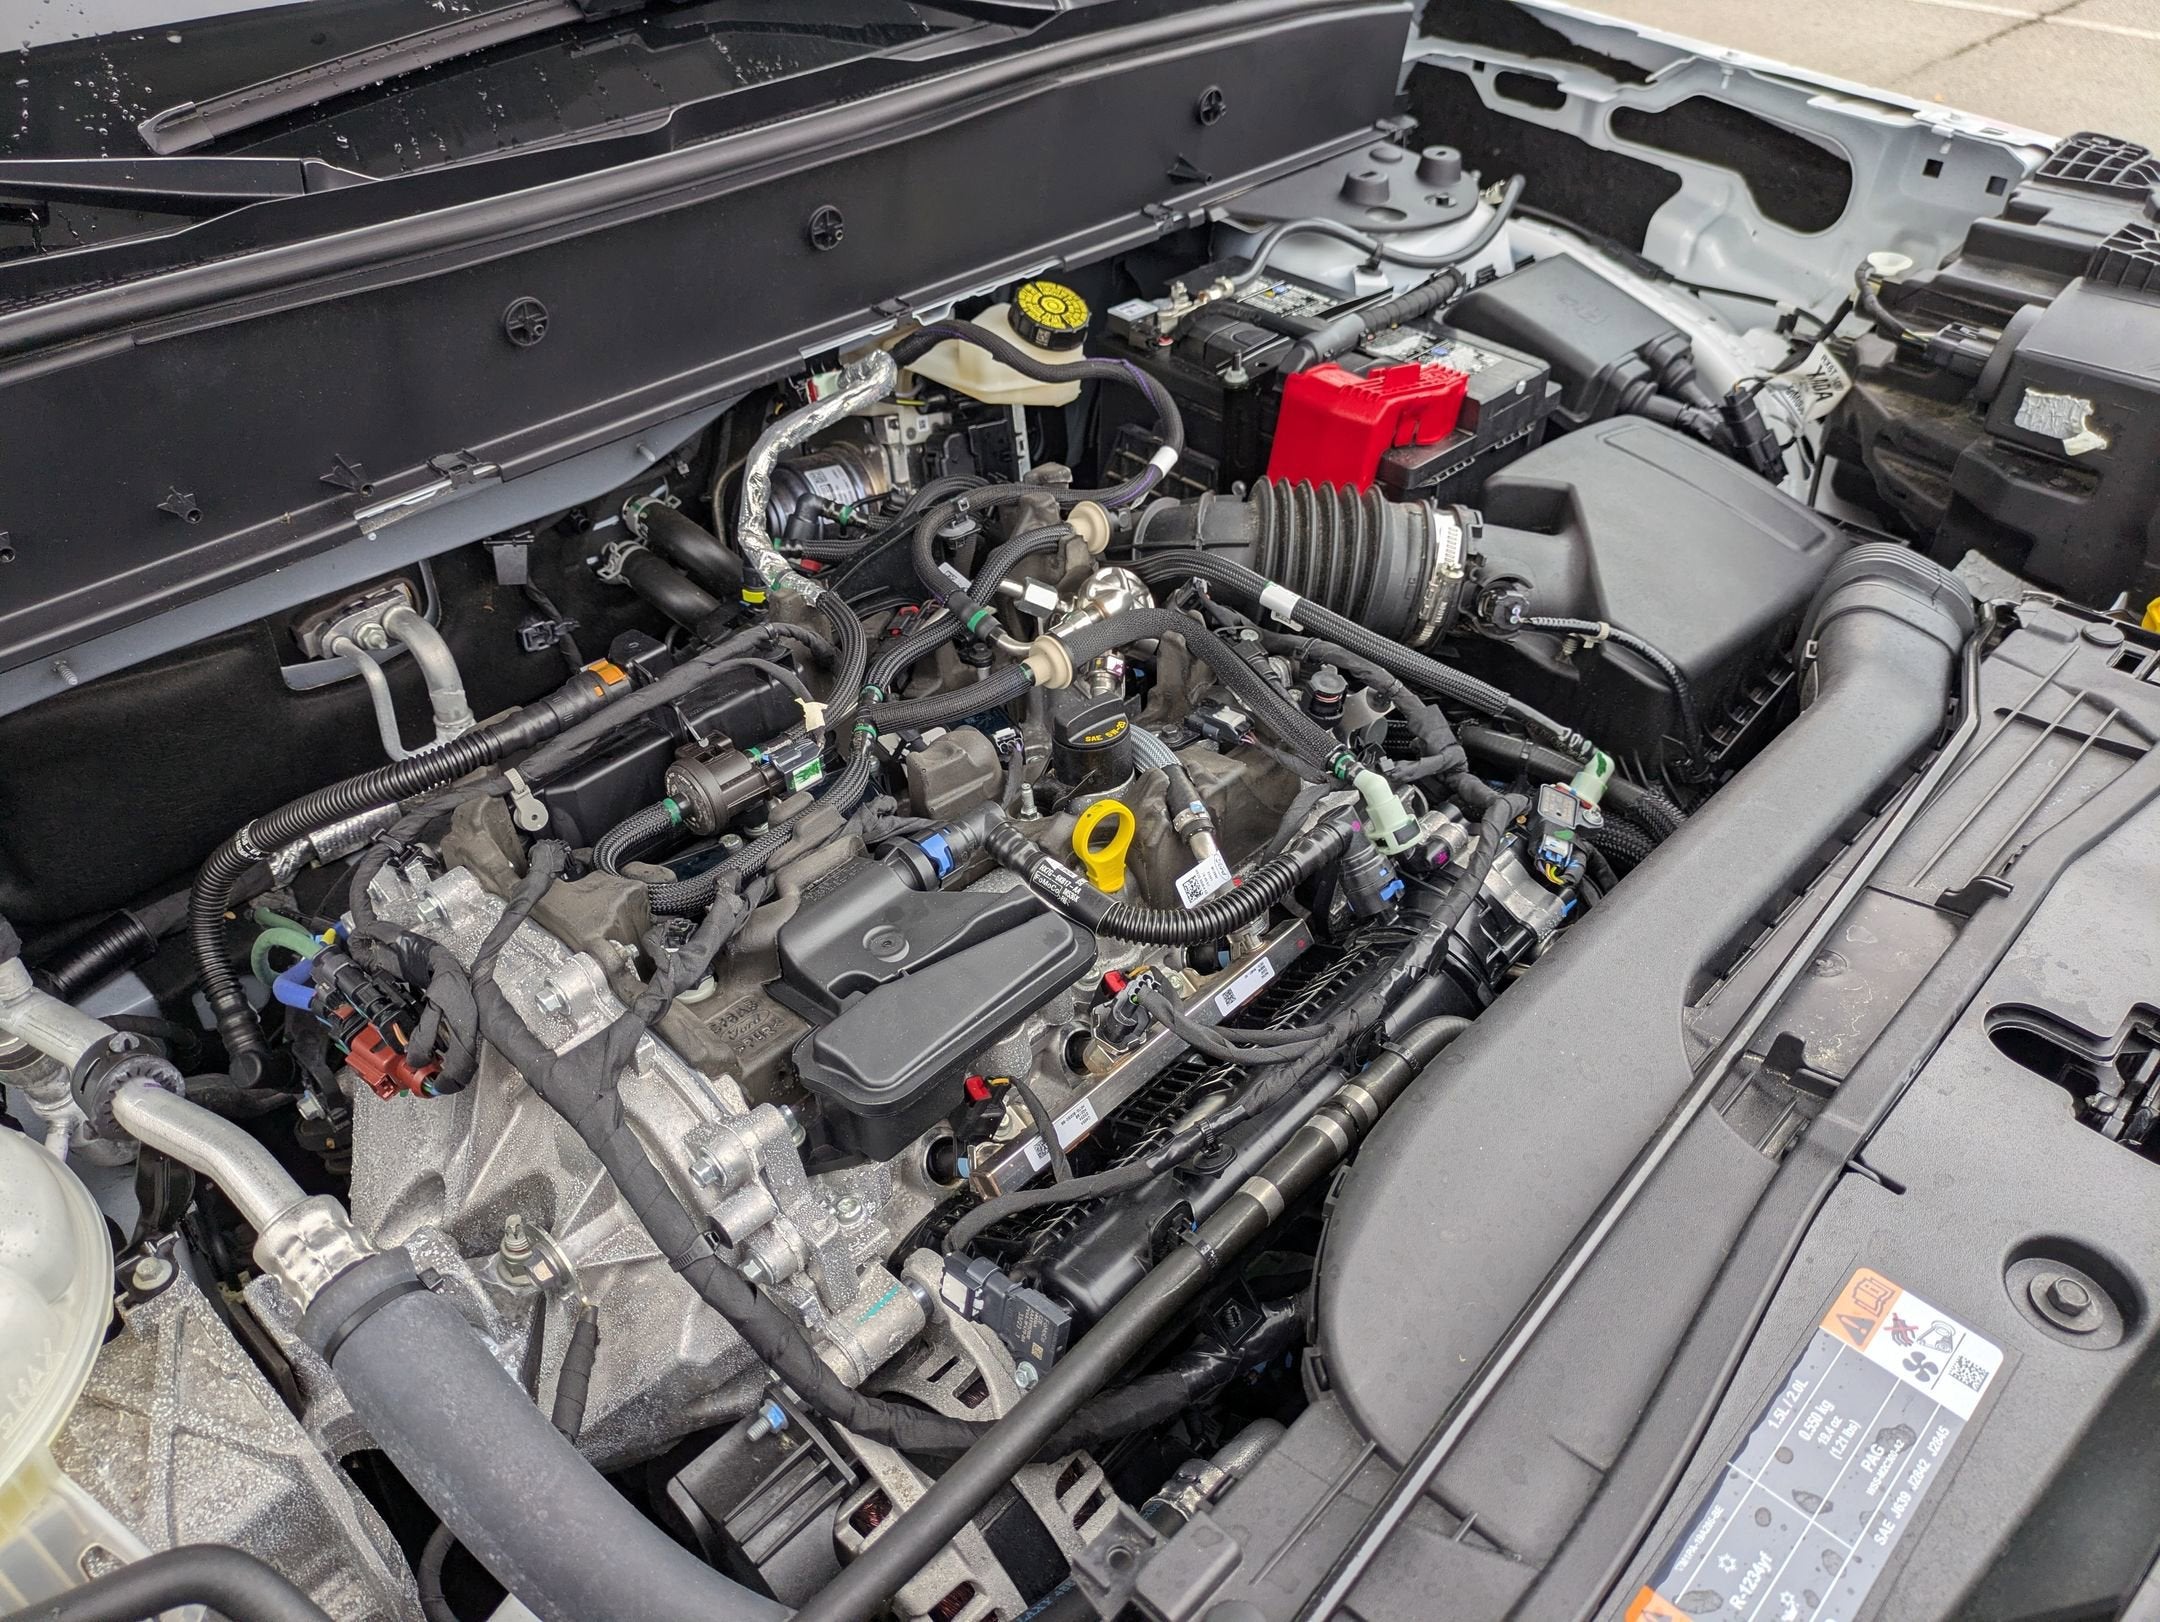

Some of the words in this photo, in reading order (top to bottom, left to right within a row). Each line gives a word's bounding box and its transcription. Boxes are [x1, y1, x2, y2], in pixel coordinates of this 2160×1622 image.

[1085, 734, 1103, 742] SAE
[1033, 871, 1060, 895] FoMoCo
[728, 1013, 760, 1041] Ford
[1767, 1407, 1791, 1429] 1.5L
[1786, 1379, 1809, 1403] 2.0L
[1798, 1411, 1824, 1441] 0.550
[1814, 1399, 1836, 1416] kg
[1817, 1425, 1836, 1446] 19.4
[1830, 1415, 1843, 1428] oz
[1841, 1418, 1862, 1439] lbs)
[1860, 1443, 1886, 1473] PAG
[1873, 1518, 1896, 1547] SAE
[1890, 1490, 1912, 1520] J639
[1907, 1457, 1931, 1492] J2842
[1926, 1424, 1951, 1458] J2845
[1729, 1550, 1773, 1611] R-1234yf
